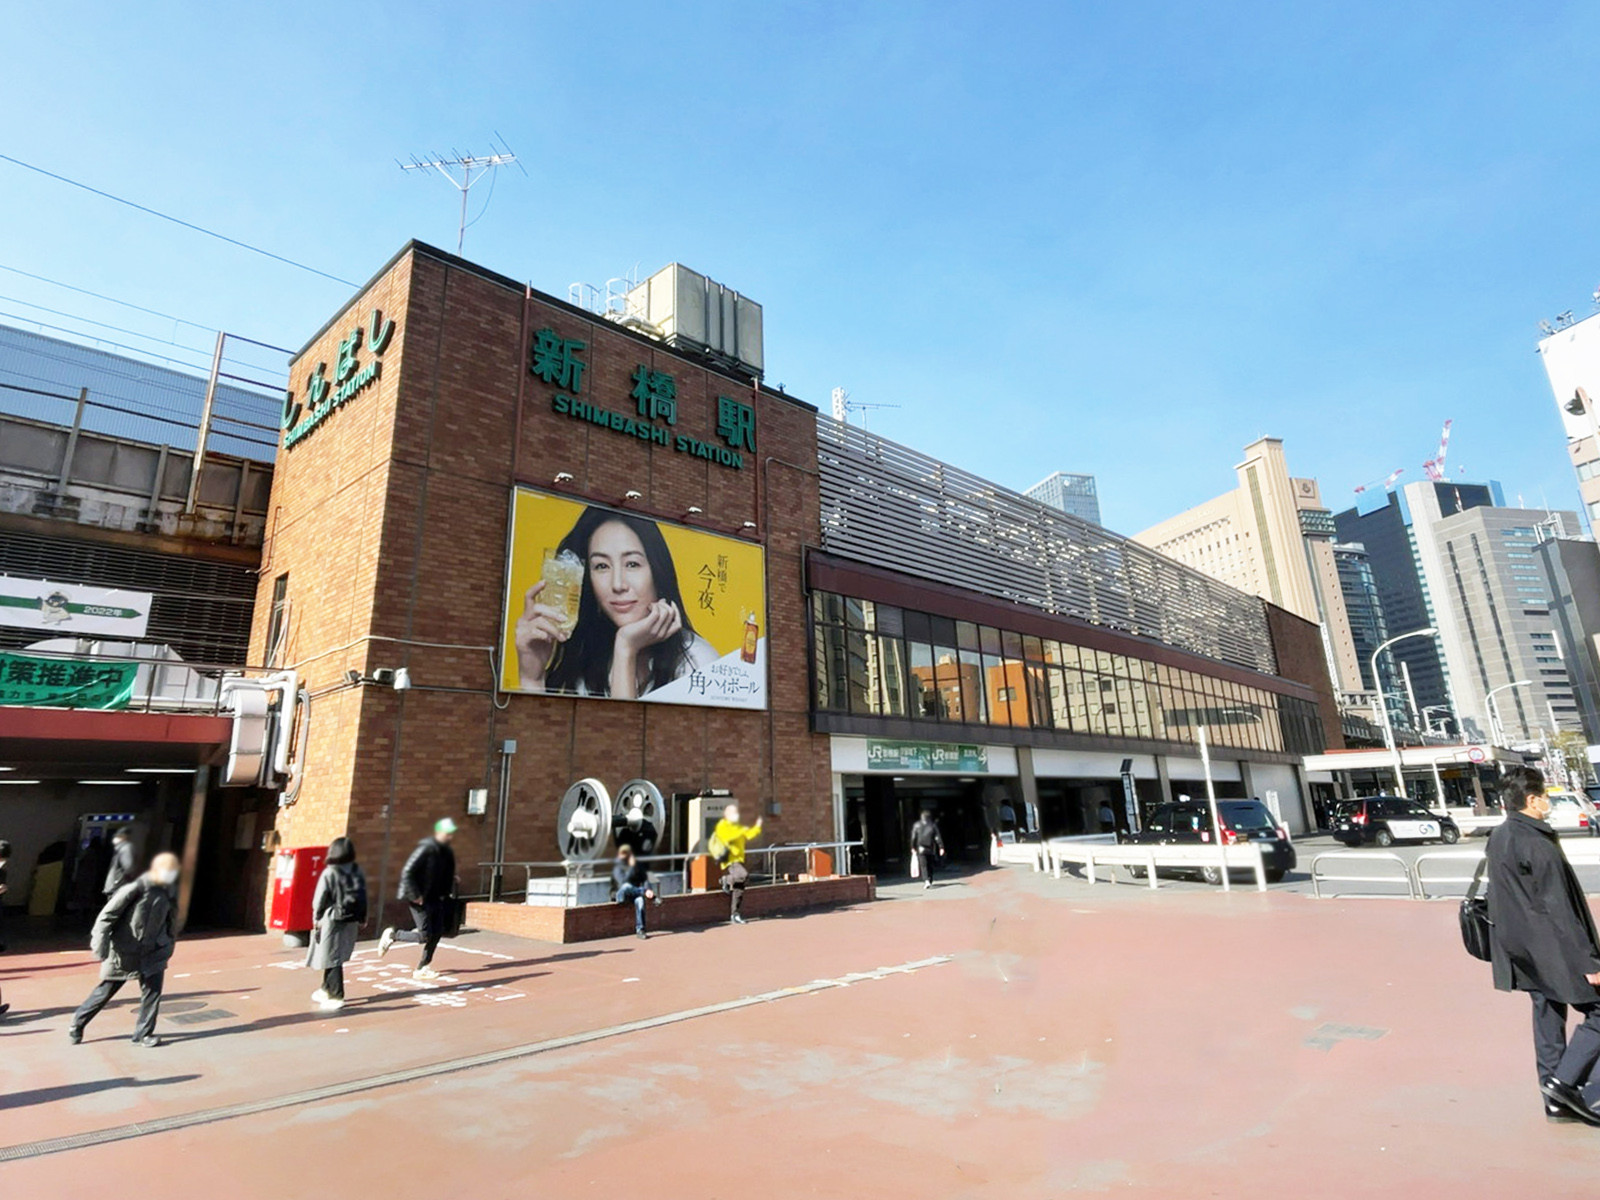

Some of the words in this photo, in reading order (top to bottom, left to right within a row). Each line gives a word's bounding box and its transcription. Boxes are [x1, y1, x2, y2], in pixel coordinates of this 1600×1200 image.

[281, 308, 396, 430] しんばし
[282, 399, 333, 450] SHIMBASHI
[332, 360, 381, 408] STATION
[531, 326, 757, 454] 新橋駅
[553, 394, 671, 447] SHIMBASHI
[674, 434, 744, 470] STATION
[83, 605, 123, 617] 2022年
[688, 668, 761, 696] 角ハイボール
